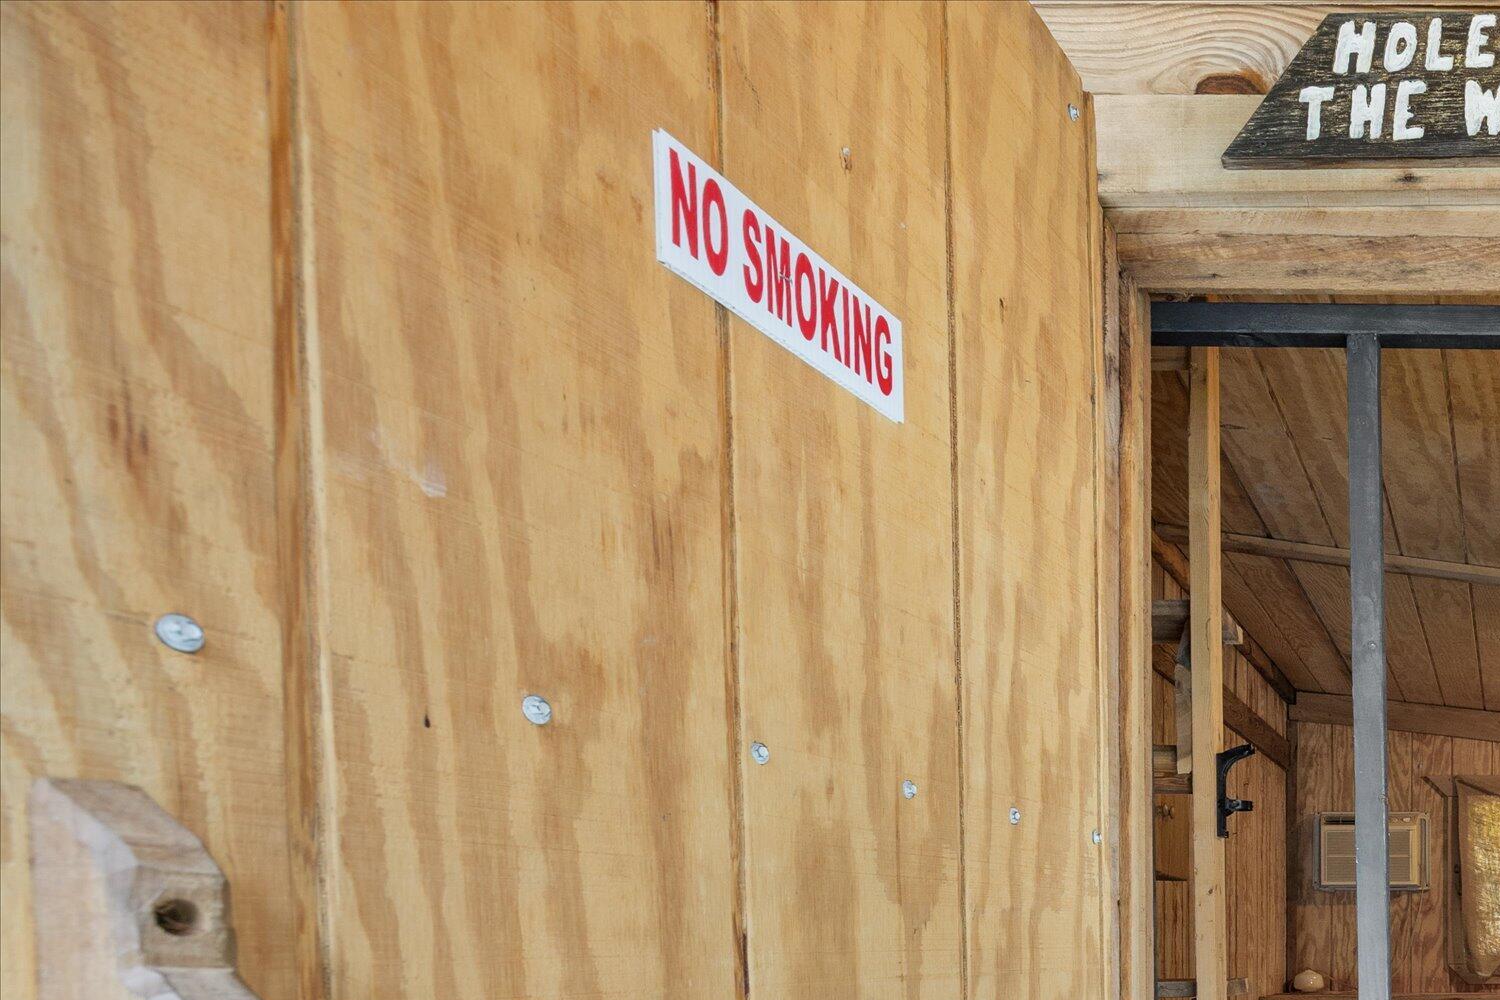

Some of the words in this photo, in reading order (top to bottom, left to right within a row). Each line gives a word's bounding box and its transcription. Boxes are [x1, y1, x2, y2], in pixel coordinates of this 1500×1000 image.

[1333, 14, 1496, 74] HOLE
[1299, 79, 1427, 141] THE
[669, 148, 729, 276] NO
[742, 208, 893, 396] SMOKING
